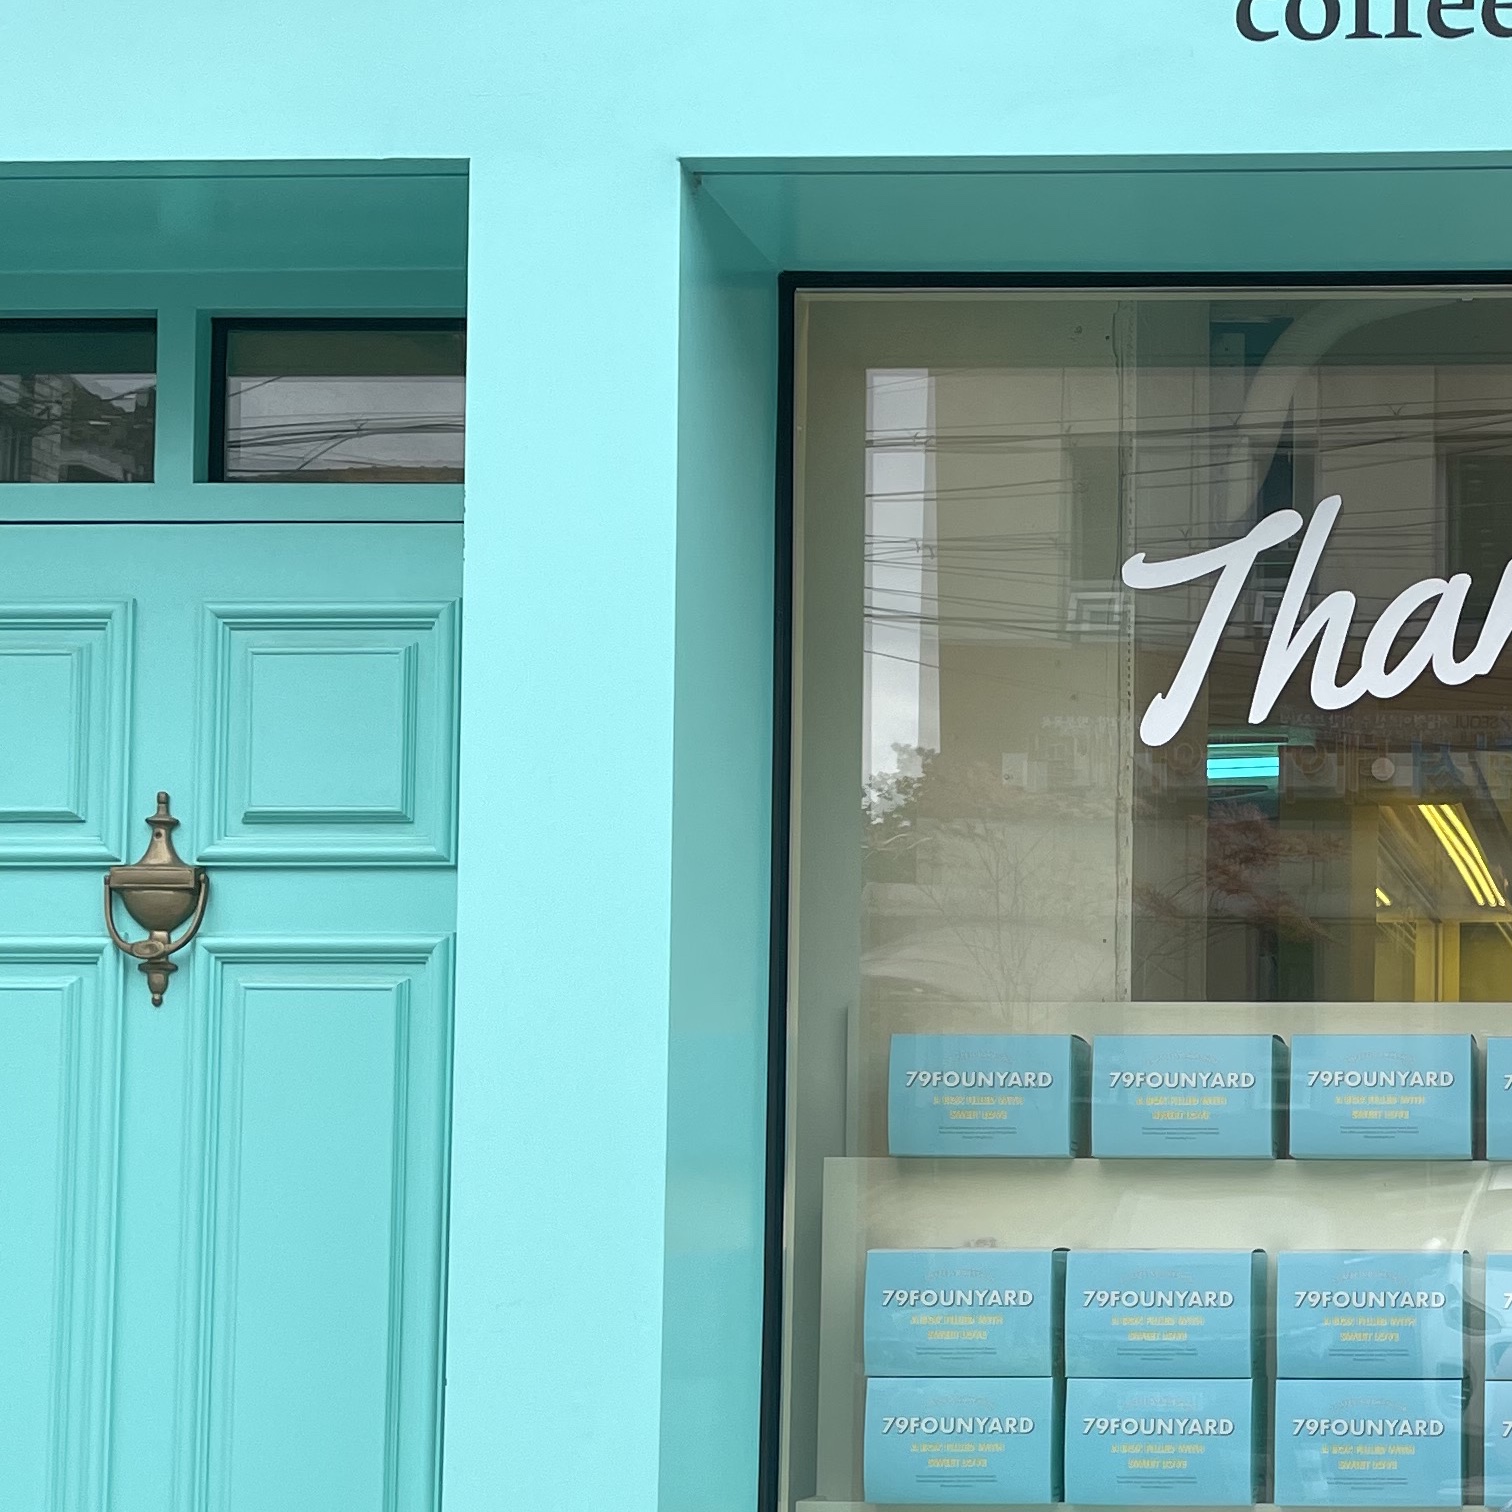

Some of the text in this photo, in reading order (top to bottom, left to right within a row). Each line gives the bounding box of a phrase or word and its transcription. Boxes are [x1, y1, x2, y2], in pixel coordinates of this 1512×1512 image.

[905, 1070, 1054, 1089] 79FOUNYARD
[1108, 1071, 1255, 1090] 79FOUNYARD
[1307, 1070, 1455, 1088] 79FOUNYARD
[881, 1289, 1034, 1308] 79FOUNYARD
[1082, 1290, 1234, 1309] 79FOUNYARD
[1294, 1291, 1446, 1309] 79FOUNYARD
[881, 1416, 1034, 1435] 79FOUNYARD
[1082, 1417, 1234, 1436] 79FOUNYARD
[1292, 1419, 1445, 1437] 79FOUNYARD
